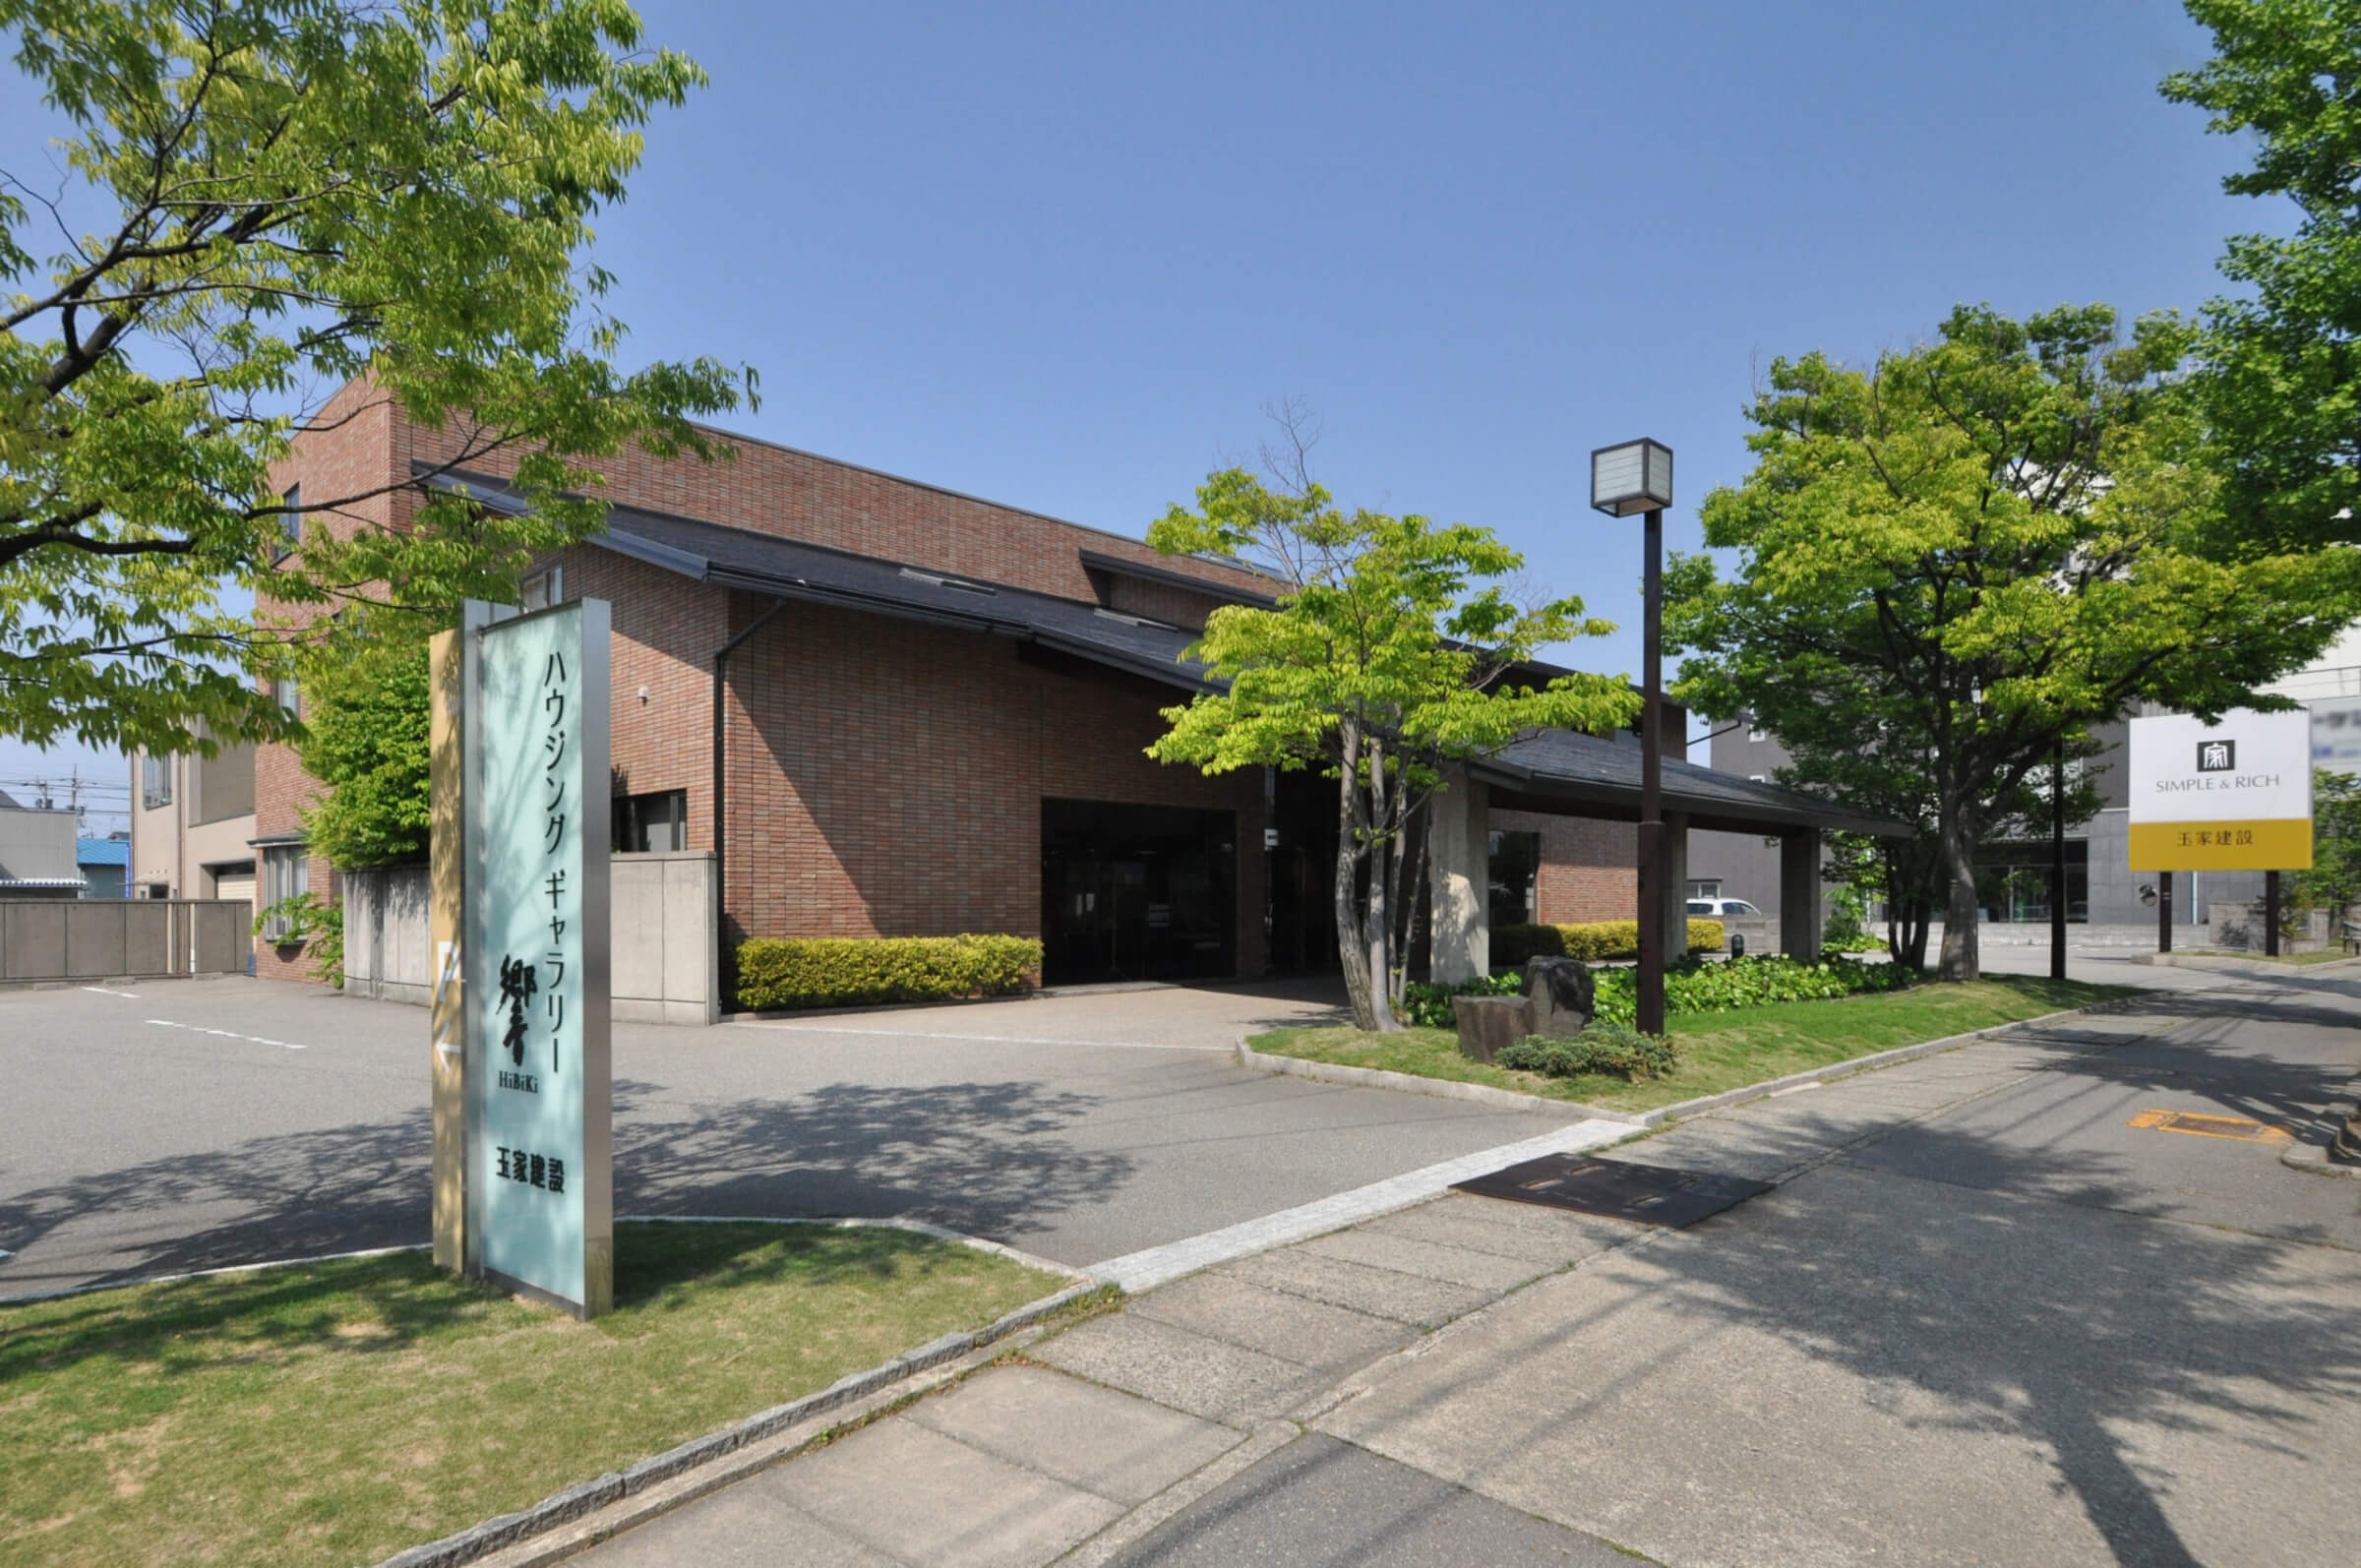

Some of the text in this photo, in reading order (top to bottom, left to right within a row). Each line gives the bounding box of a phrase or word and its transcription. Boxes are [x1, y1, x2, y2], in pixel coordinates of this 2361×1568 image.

[2155, 773, 2280, 793] SIMPLE & RICH
[2176, 829, 2254, 847] 玉家建設
[545, 650, 567, 1074] ハウジング ギャラリー
[437, 940, 461, 1002] P
[498, 1069, 539, 1094] HiBiKi
[496, 1145, 566, 1194] 玉家建設
